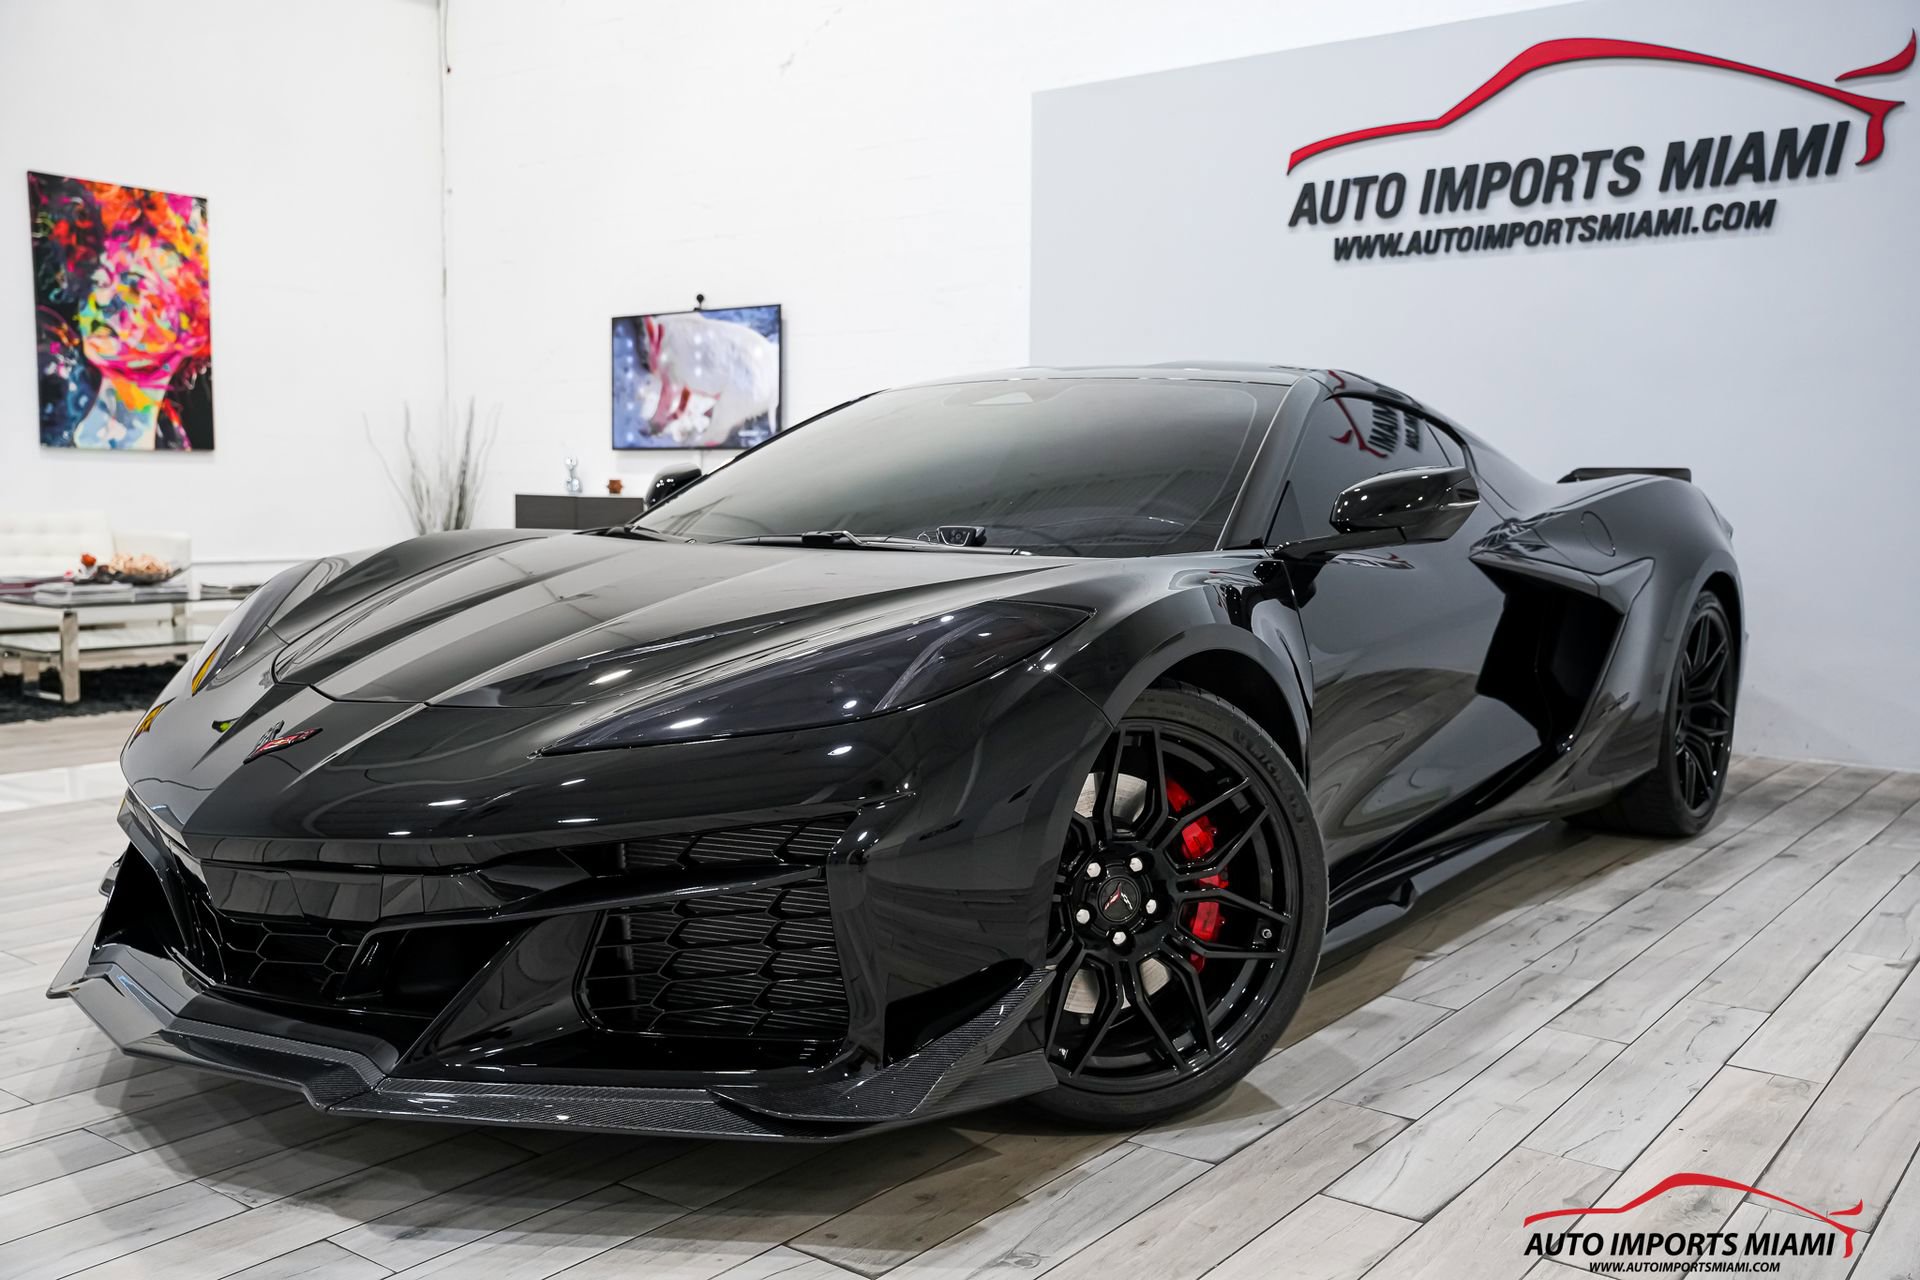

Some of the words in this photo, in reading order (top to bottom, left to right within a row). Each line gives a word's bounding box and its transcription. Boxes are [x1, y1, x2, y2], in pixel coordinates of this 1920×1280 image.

[1288, 173, 1406, 227] AUTO
[1419, 146, 1645, 215] IMPORTS
[1659, 121, 1850, 192] MIAMI
[1335, 200, 1777, 261] WWW.AUTOIMPORTSMIAMI.COM
